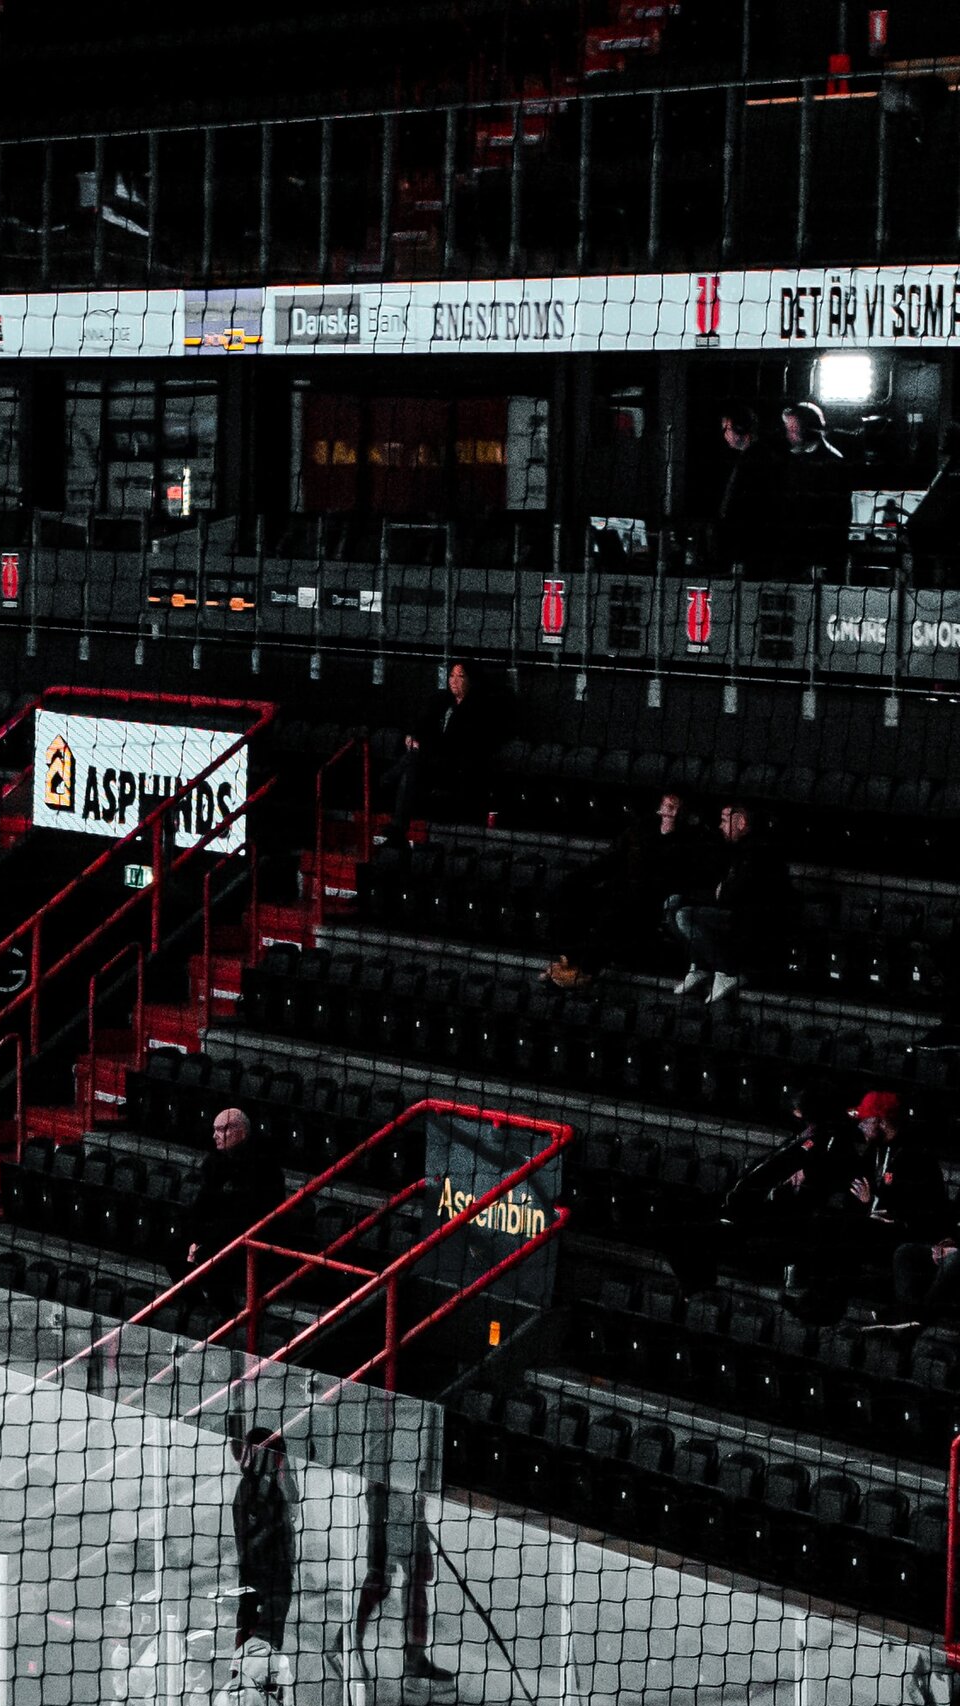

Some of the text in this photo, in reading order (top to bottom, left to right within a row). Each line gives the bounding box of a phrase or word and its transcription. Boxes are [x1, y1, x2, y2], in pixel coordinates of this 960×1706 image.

[292, 307, 359, 335] Danske
[780, 287, 821, 339] DET
[865, 284, 885, 337] VI
[892, 284, 944, 337] SOM
